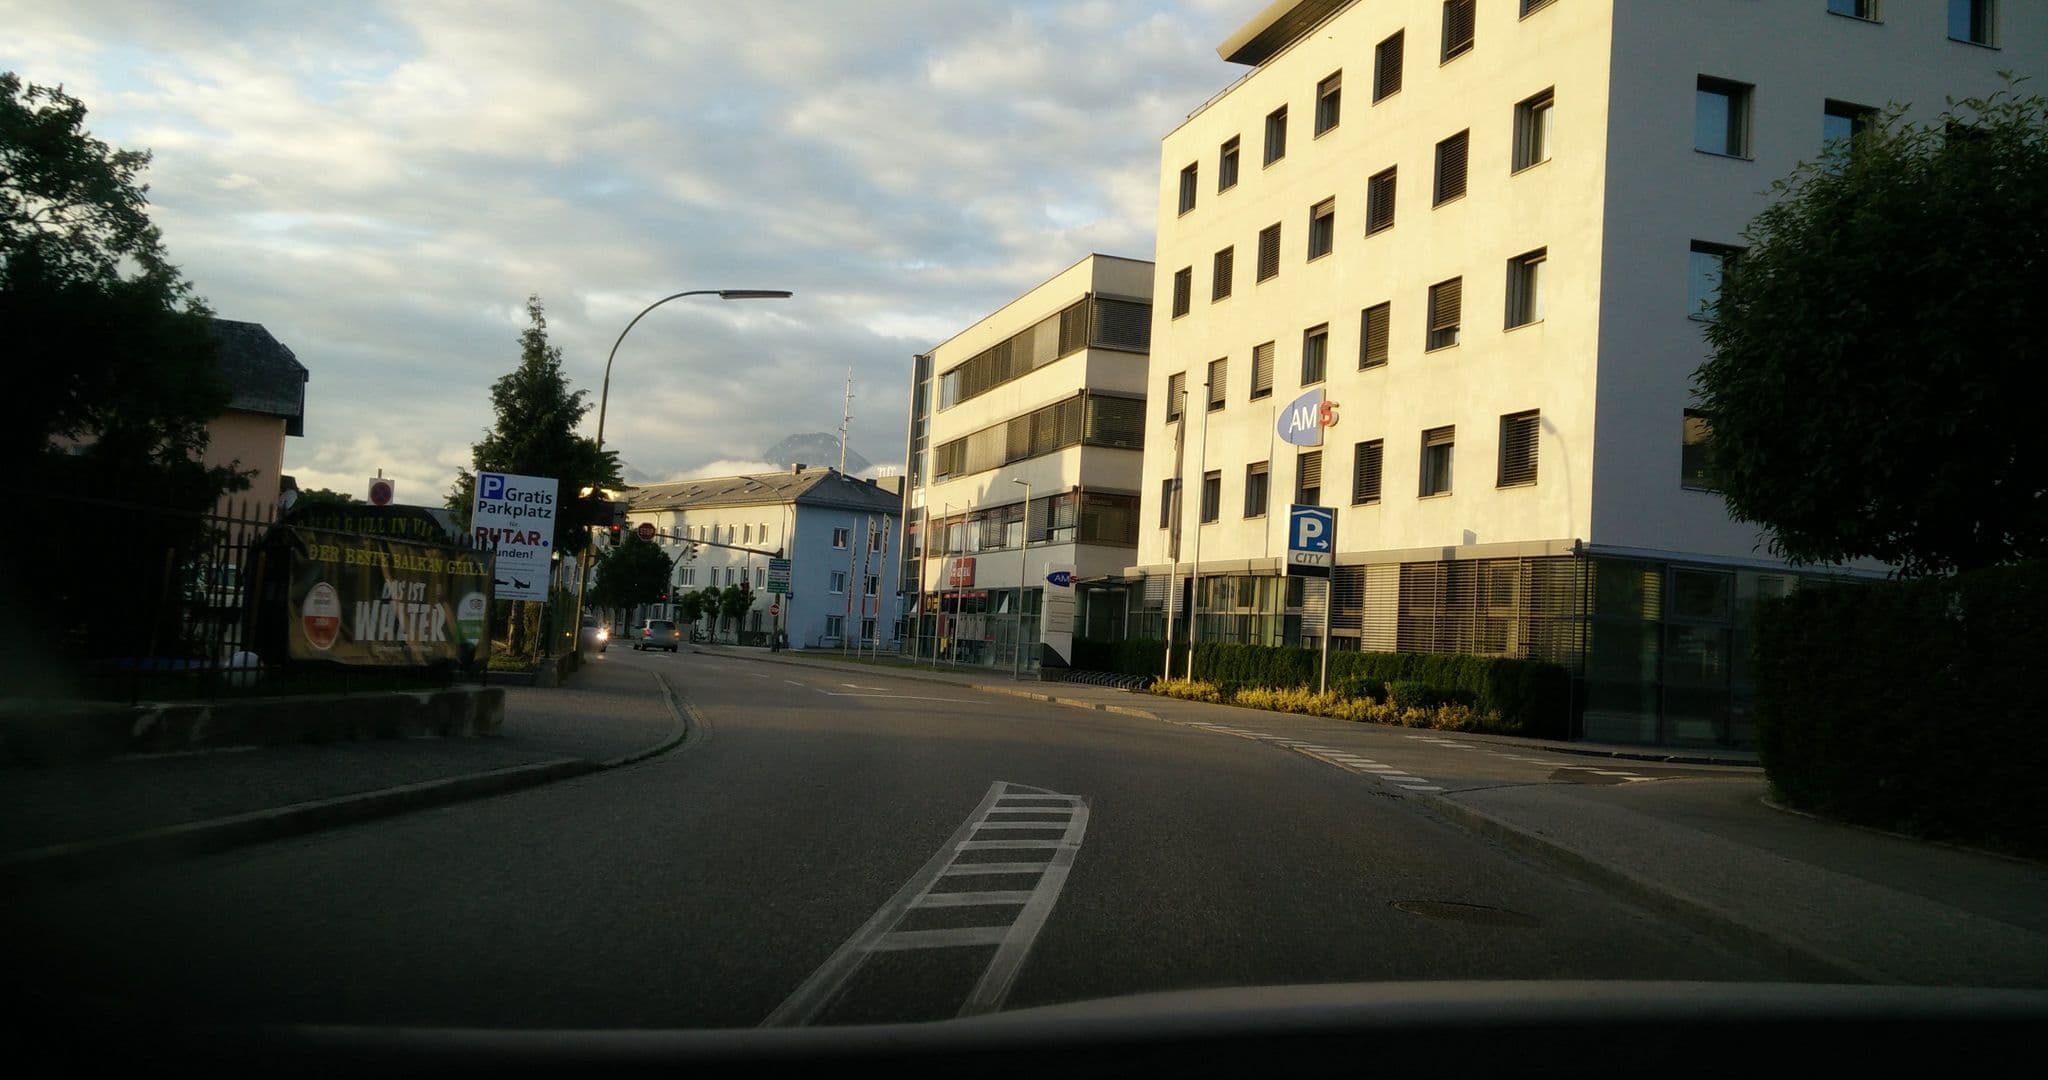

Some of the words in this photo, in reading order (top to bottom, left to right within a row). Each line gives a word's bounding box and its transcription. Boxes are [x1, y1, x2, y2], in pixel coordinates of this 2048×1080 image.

[1288, 401, 1335, 433] AMS
[483, 477, 502, 497] P
[505, 488, 553, 505] Gratis
[478, 500, 552, 519] Parkplatz
[1299, 517, 1323, 547] P
[308, 543, 340, 562] DER
[345, 548, 390, 568] BESTE
[393, 554, 443, 574] BALKAN
[495, 549, 533, 560] unden!
[1295, 553, 1323, 565] CITY
[1054, 574, 1077, 584] AMS
[407, 581, 426, 600] IST
[354, 600, 447, 641] WALTER
